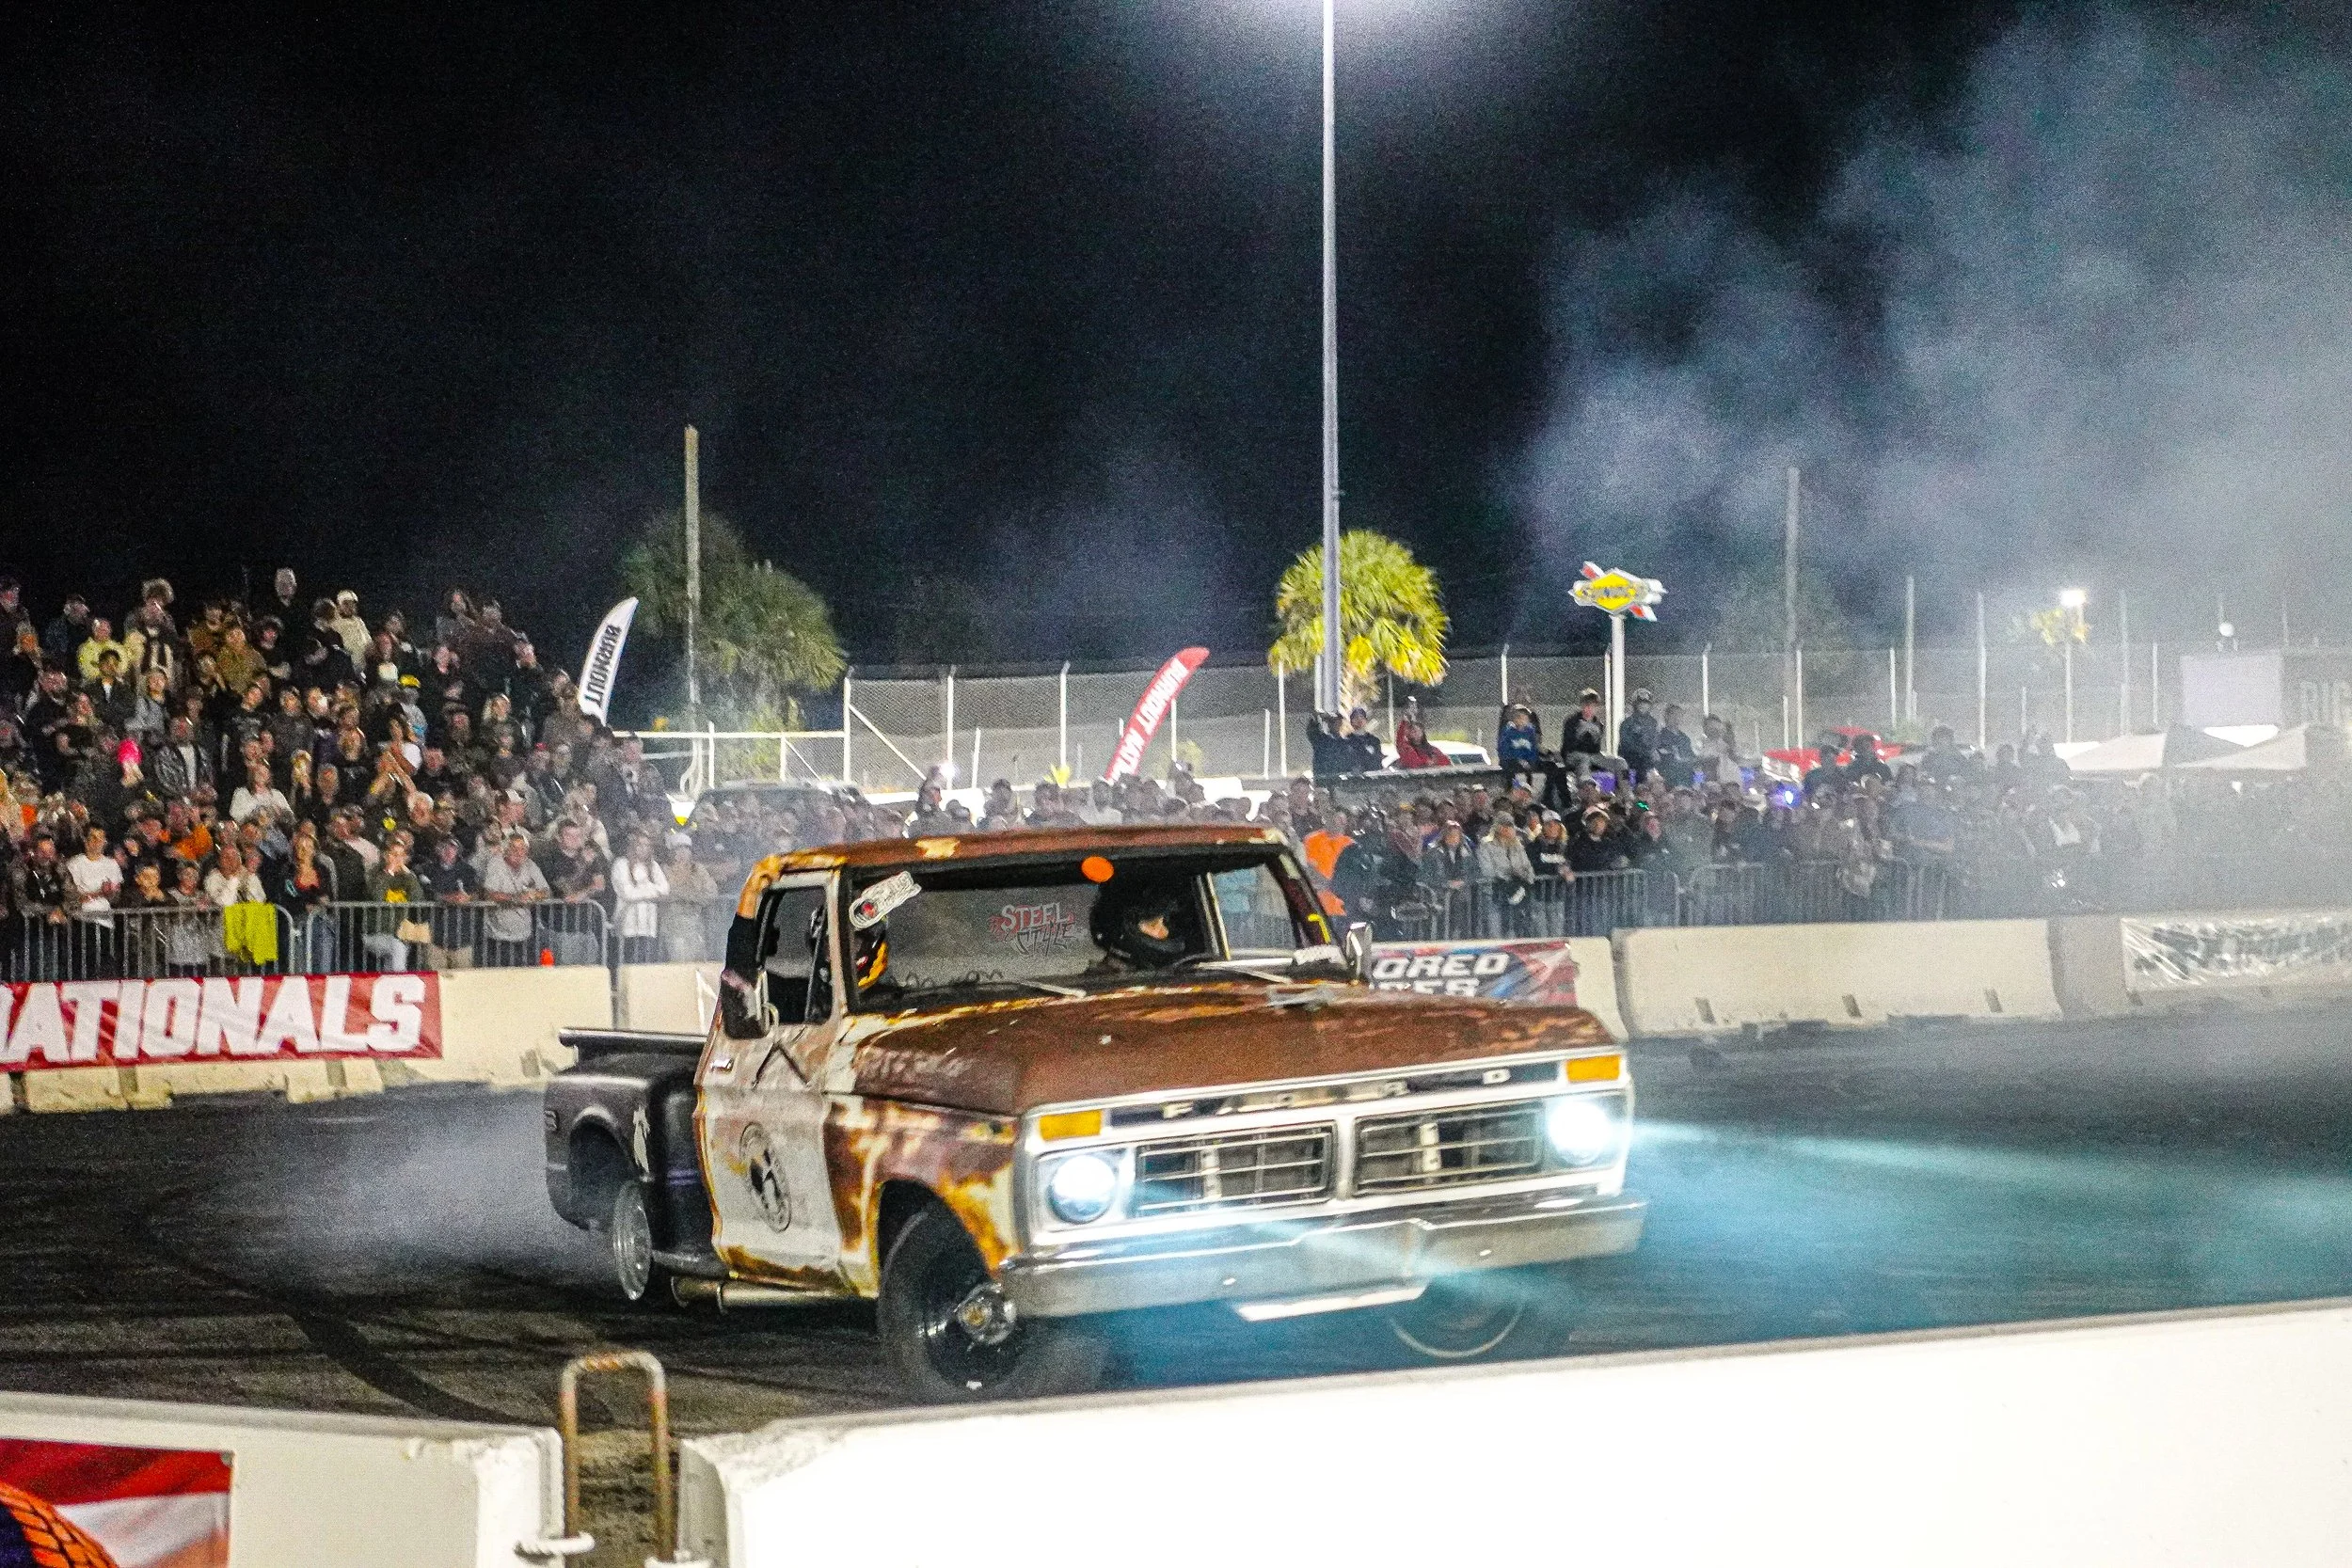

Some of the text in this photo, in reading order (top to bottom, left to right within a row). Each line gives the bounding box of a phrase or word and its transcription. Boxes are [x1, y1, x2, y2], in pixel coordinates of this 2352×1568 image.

[583, 623, 622, 708] BURNOUT
[1001, 902, 1072, 932] STEEL
[1372, 952, 1511, 980] ORED
[0, 974, 426, 1064] ATIONALS
[1162, 1069, 1511, 1119] FORD
